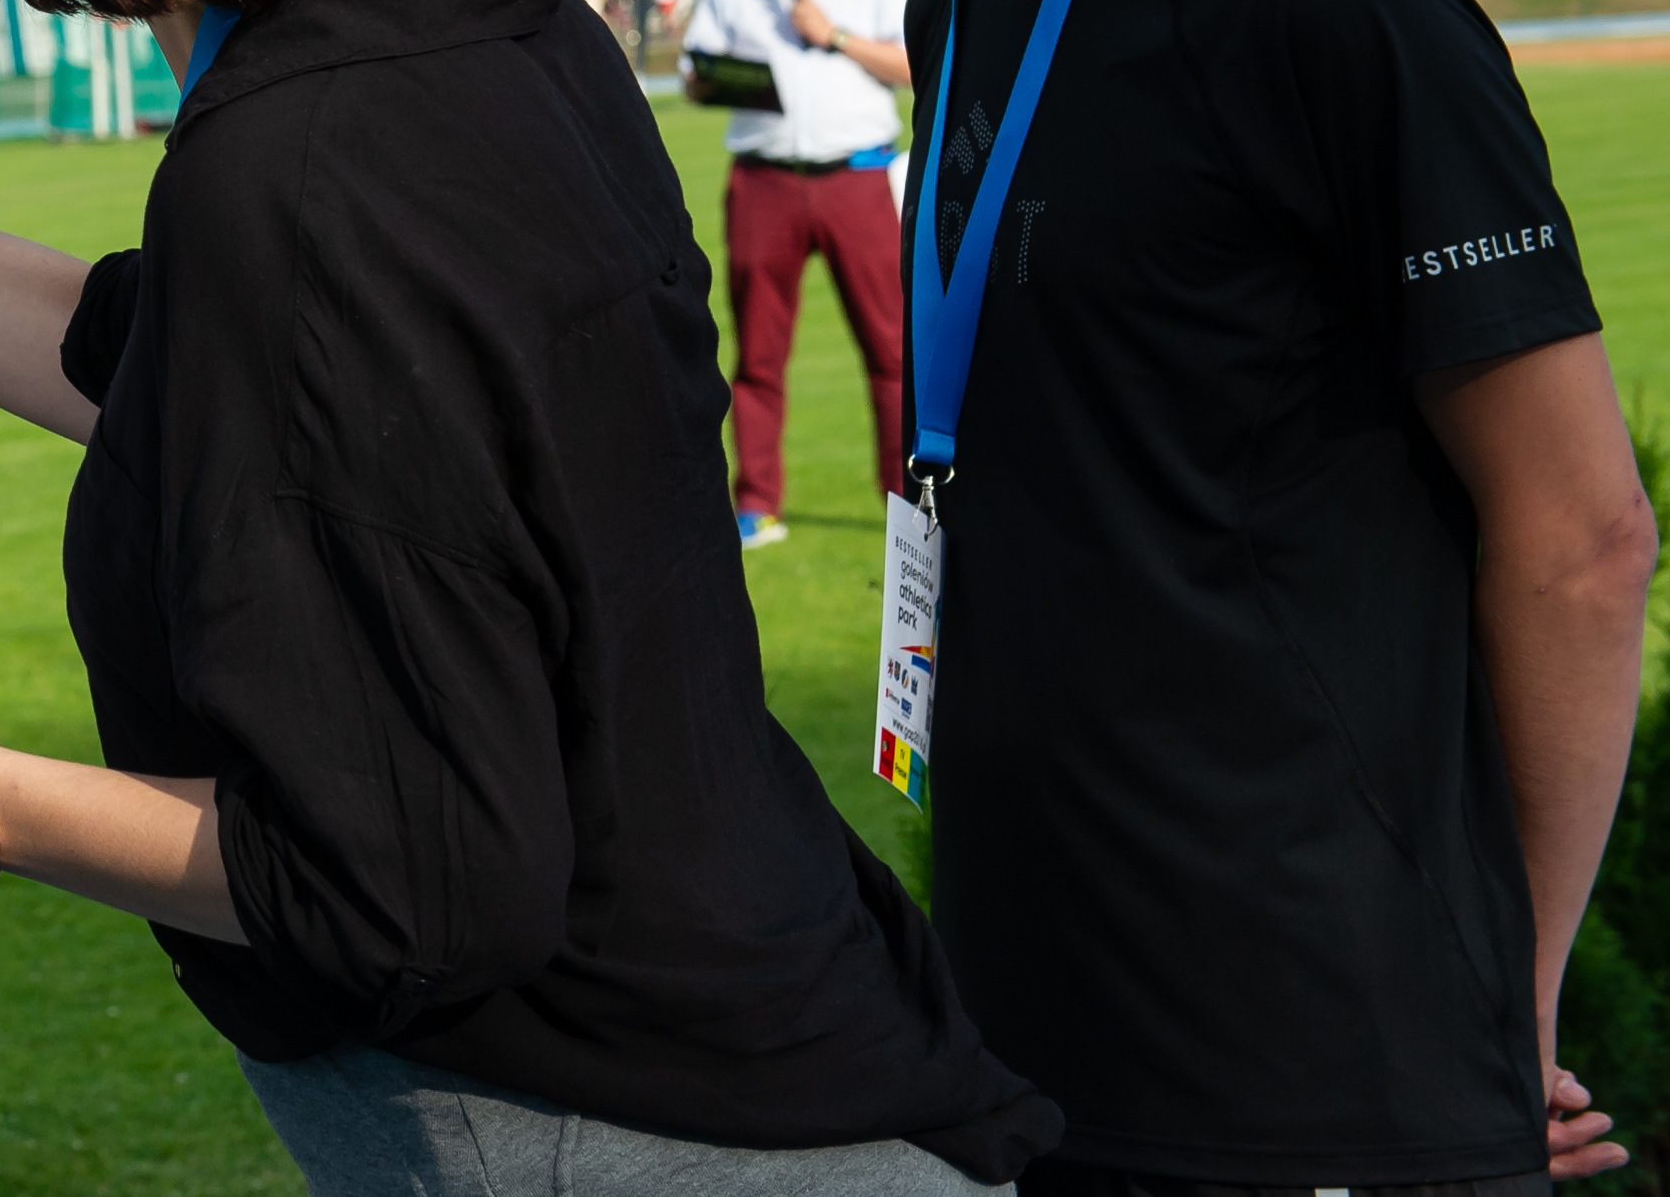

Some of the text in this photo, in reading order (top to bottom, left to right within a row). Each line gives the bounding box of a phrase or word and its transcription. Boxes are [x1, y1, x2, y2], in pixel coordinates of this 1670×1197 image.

[1401, 224, 1555, 284] ESTSELLER
[895, 535, 933, 571] BESTSELLER
[901, 560, 934, 593] goleniów
[897, 605, 918, 631] park
[899, 584, 933, 619] athletics
